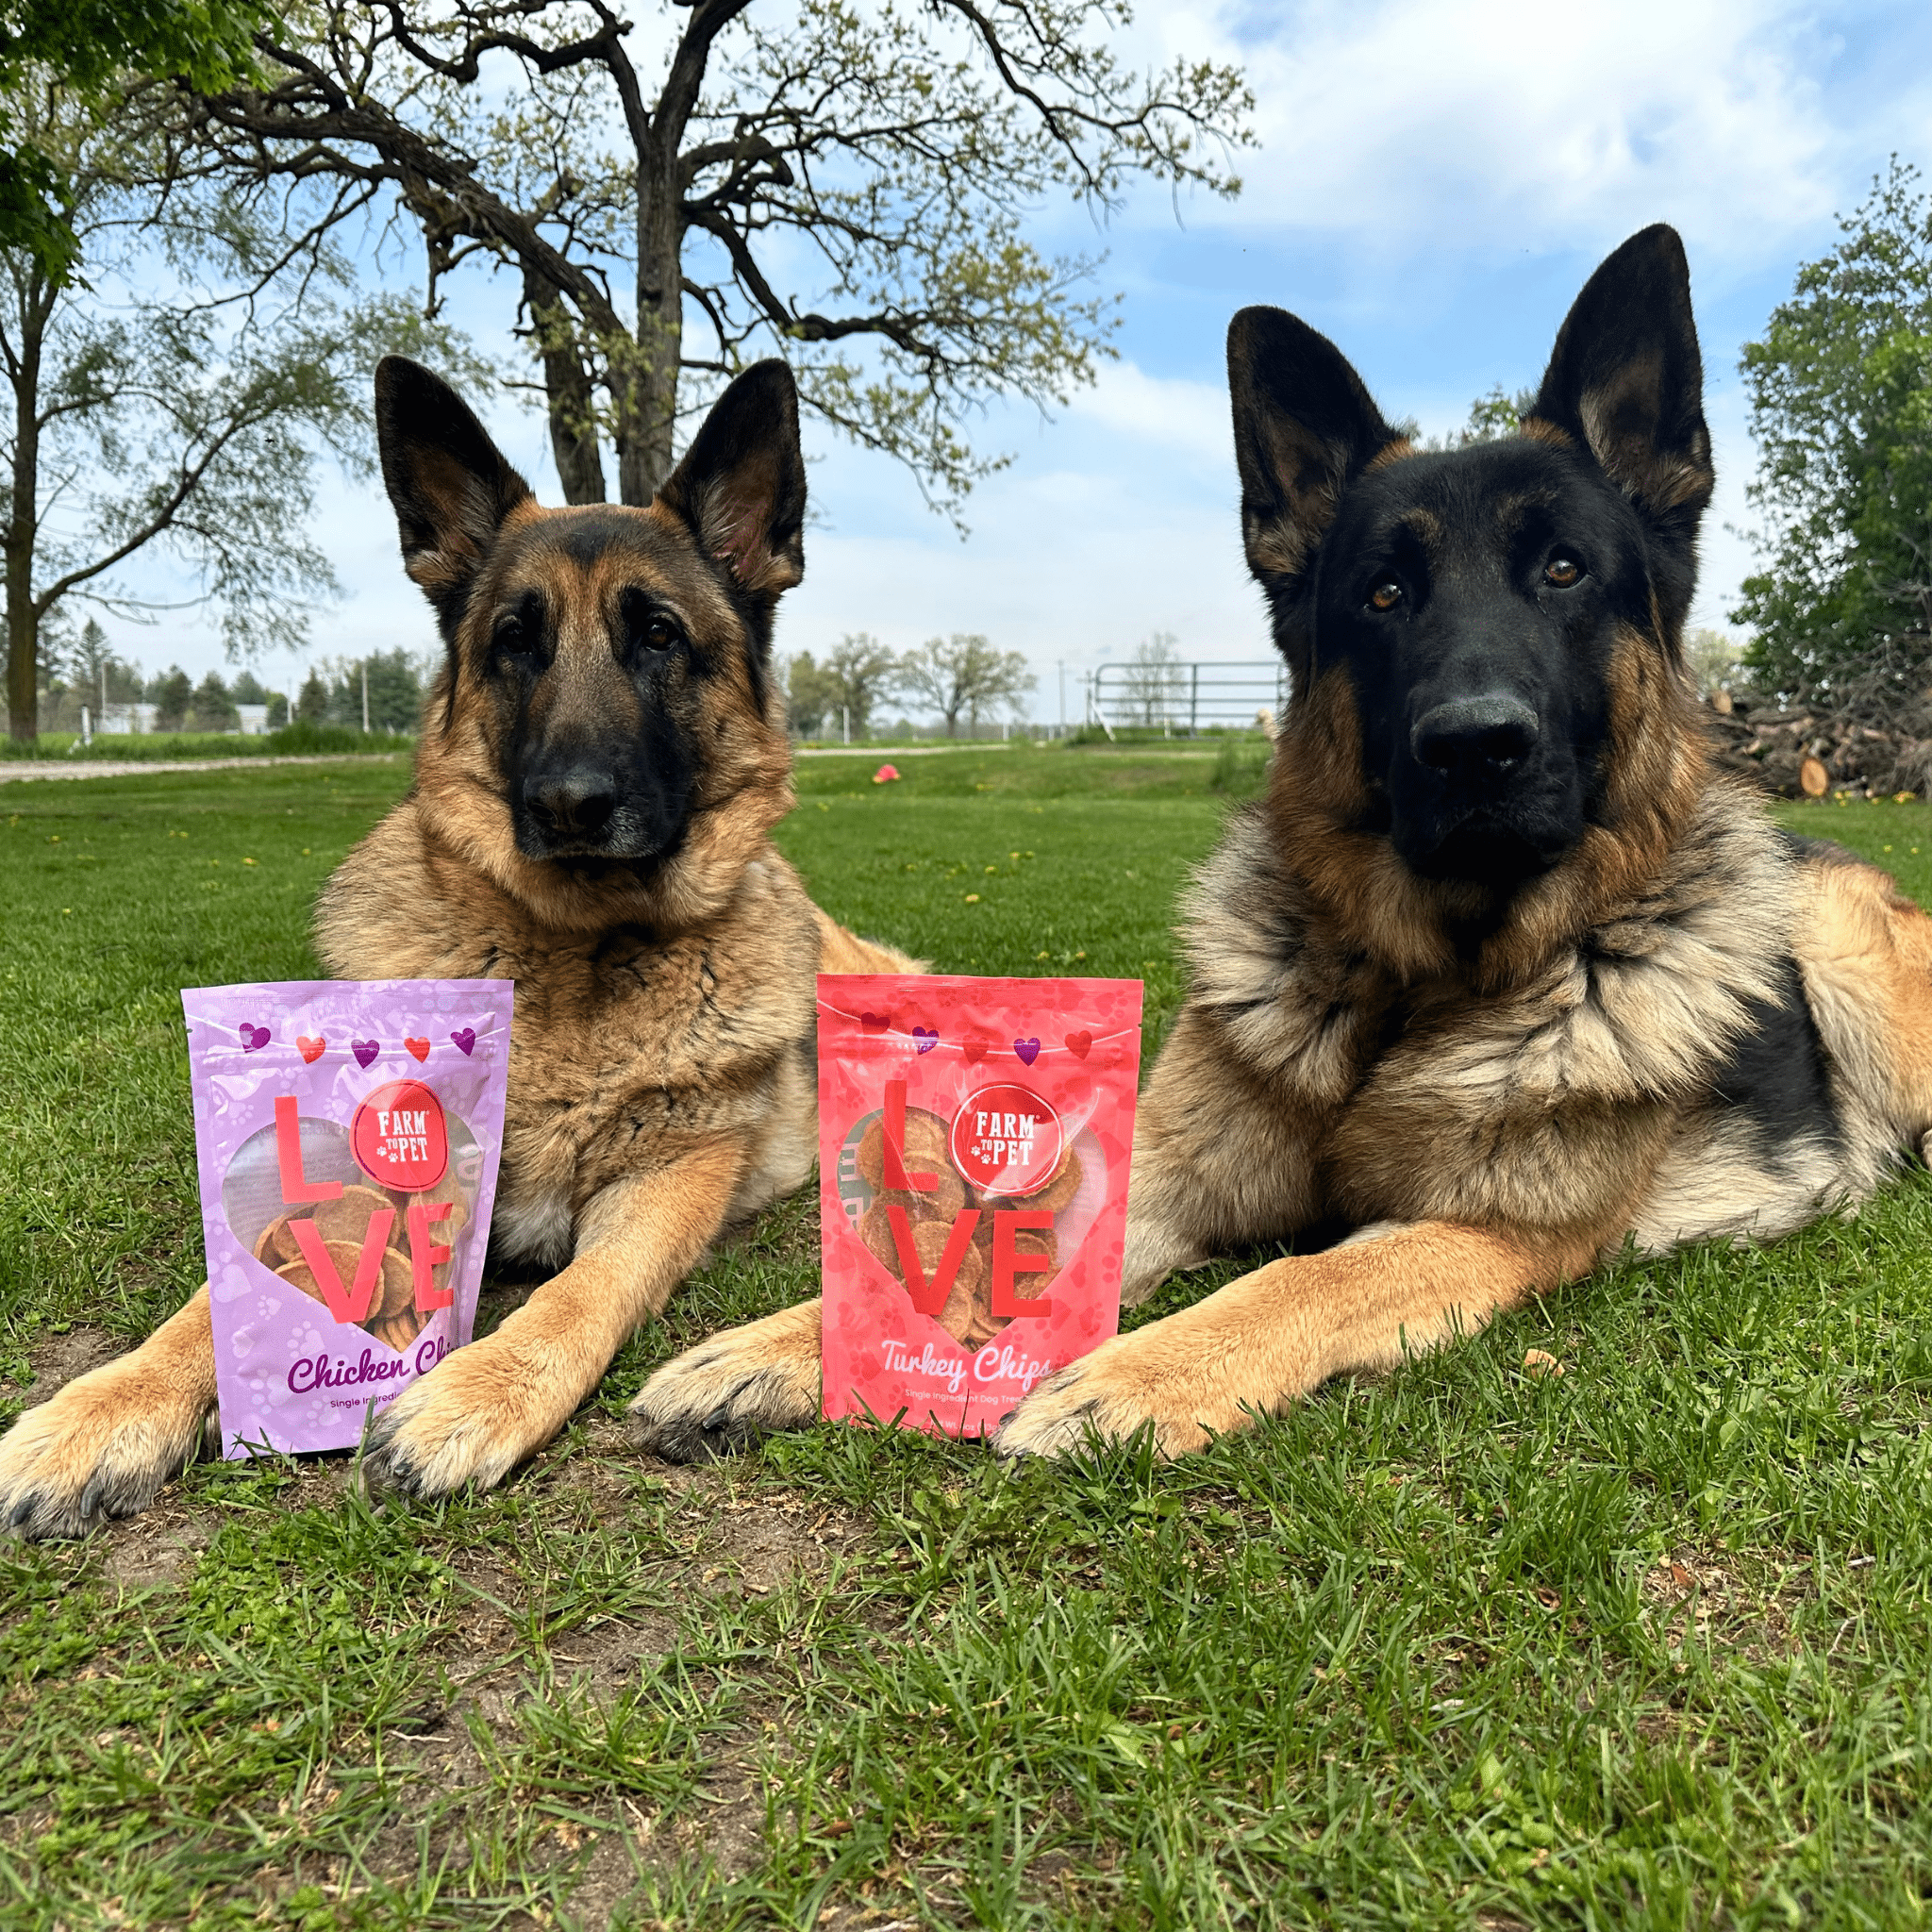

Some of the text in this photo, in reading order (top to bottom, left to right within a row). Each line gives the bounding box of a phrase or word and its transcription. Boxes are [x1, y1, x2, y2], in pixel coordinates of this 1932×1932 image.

[377, 1110, 426, 1137] FARM
[975, 1111, 1035, 1139] FARM
[386, 1137, 428, 1162] TO PET
[981, 1139, 1033, 1165] TO PET
[288, 1335, 455, 1393] Chicken Chi
[881, 1340, 1053, 1393] Turkey Chips
[330, 1399, 360, 1409] Single
[905, 1389, 931, 1401] Single
[980, 1394, 999, 1406] Dog
